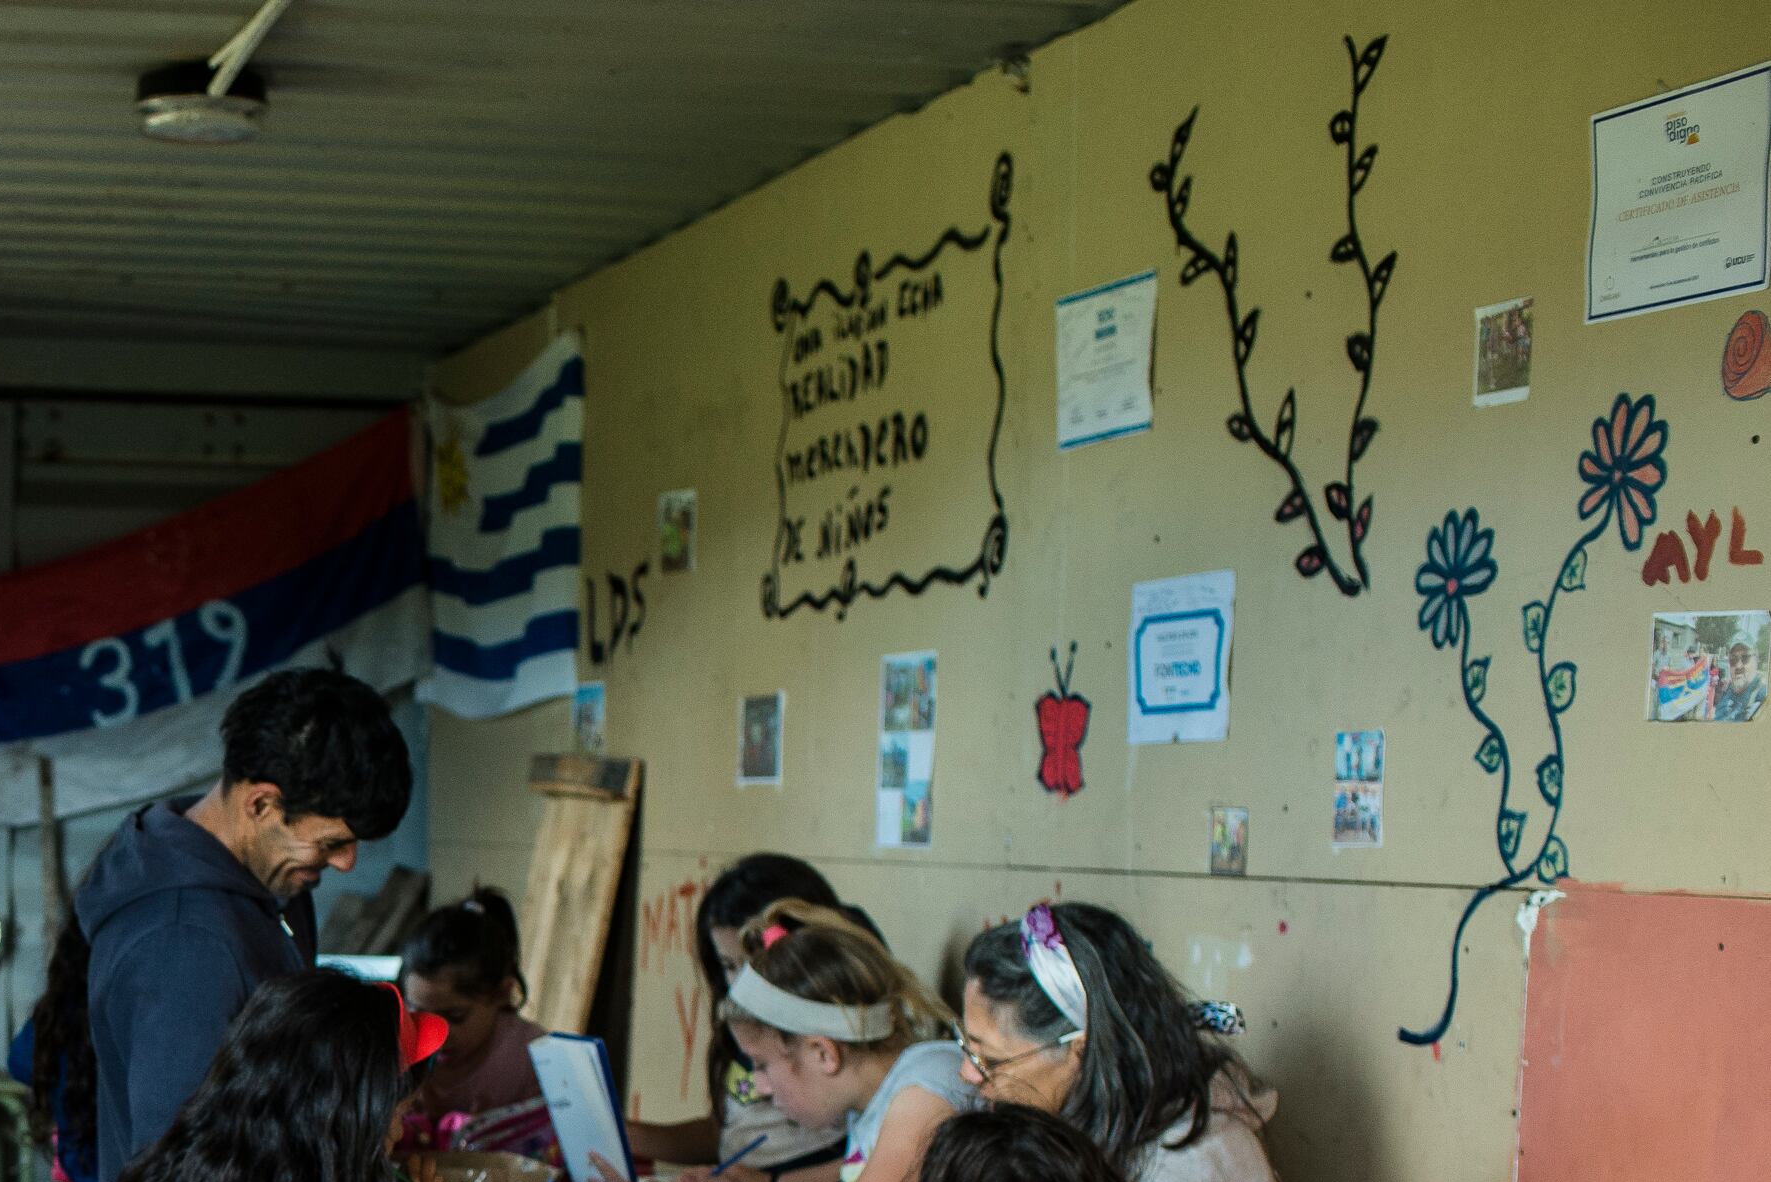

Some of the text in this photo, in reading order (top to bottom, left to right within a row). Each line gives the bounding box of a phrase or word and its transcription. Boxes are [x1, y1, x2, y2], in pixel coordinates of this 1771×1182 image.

[1638, 179, 1688, 199] CONVIVENCIA
[1651, 162, 1711, 186] CONSTRUYENDO
[1618, 182, 1741, 222] CERTIFICADO DE ASISTENCIA
[78, 600, 248, 728] 319
